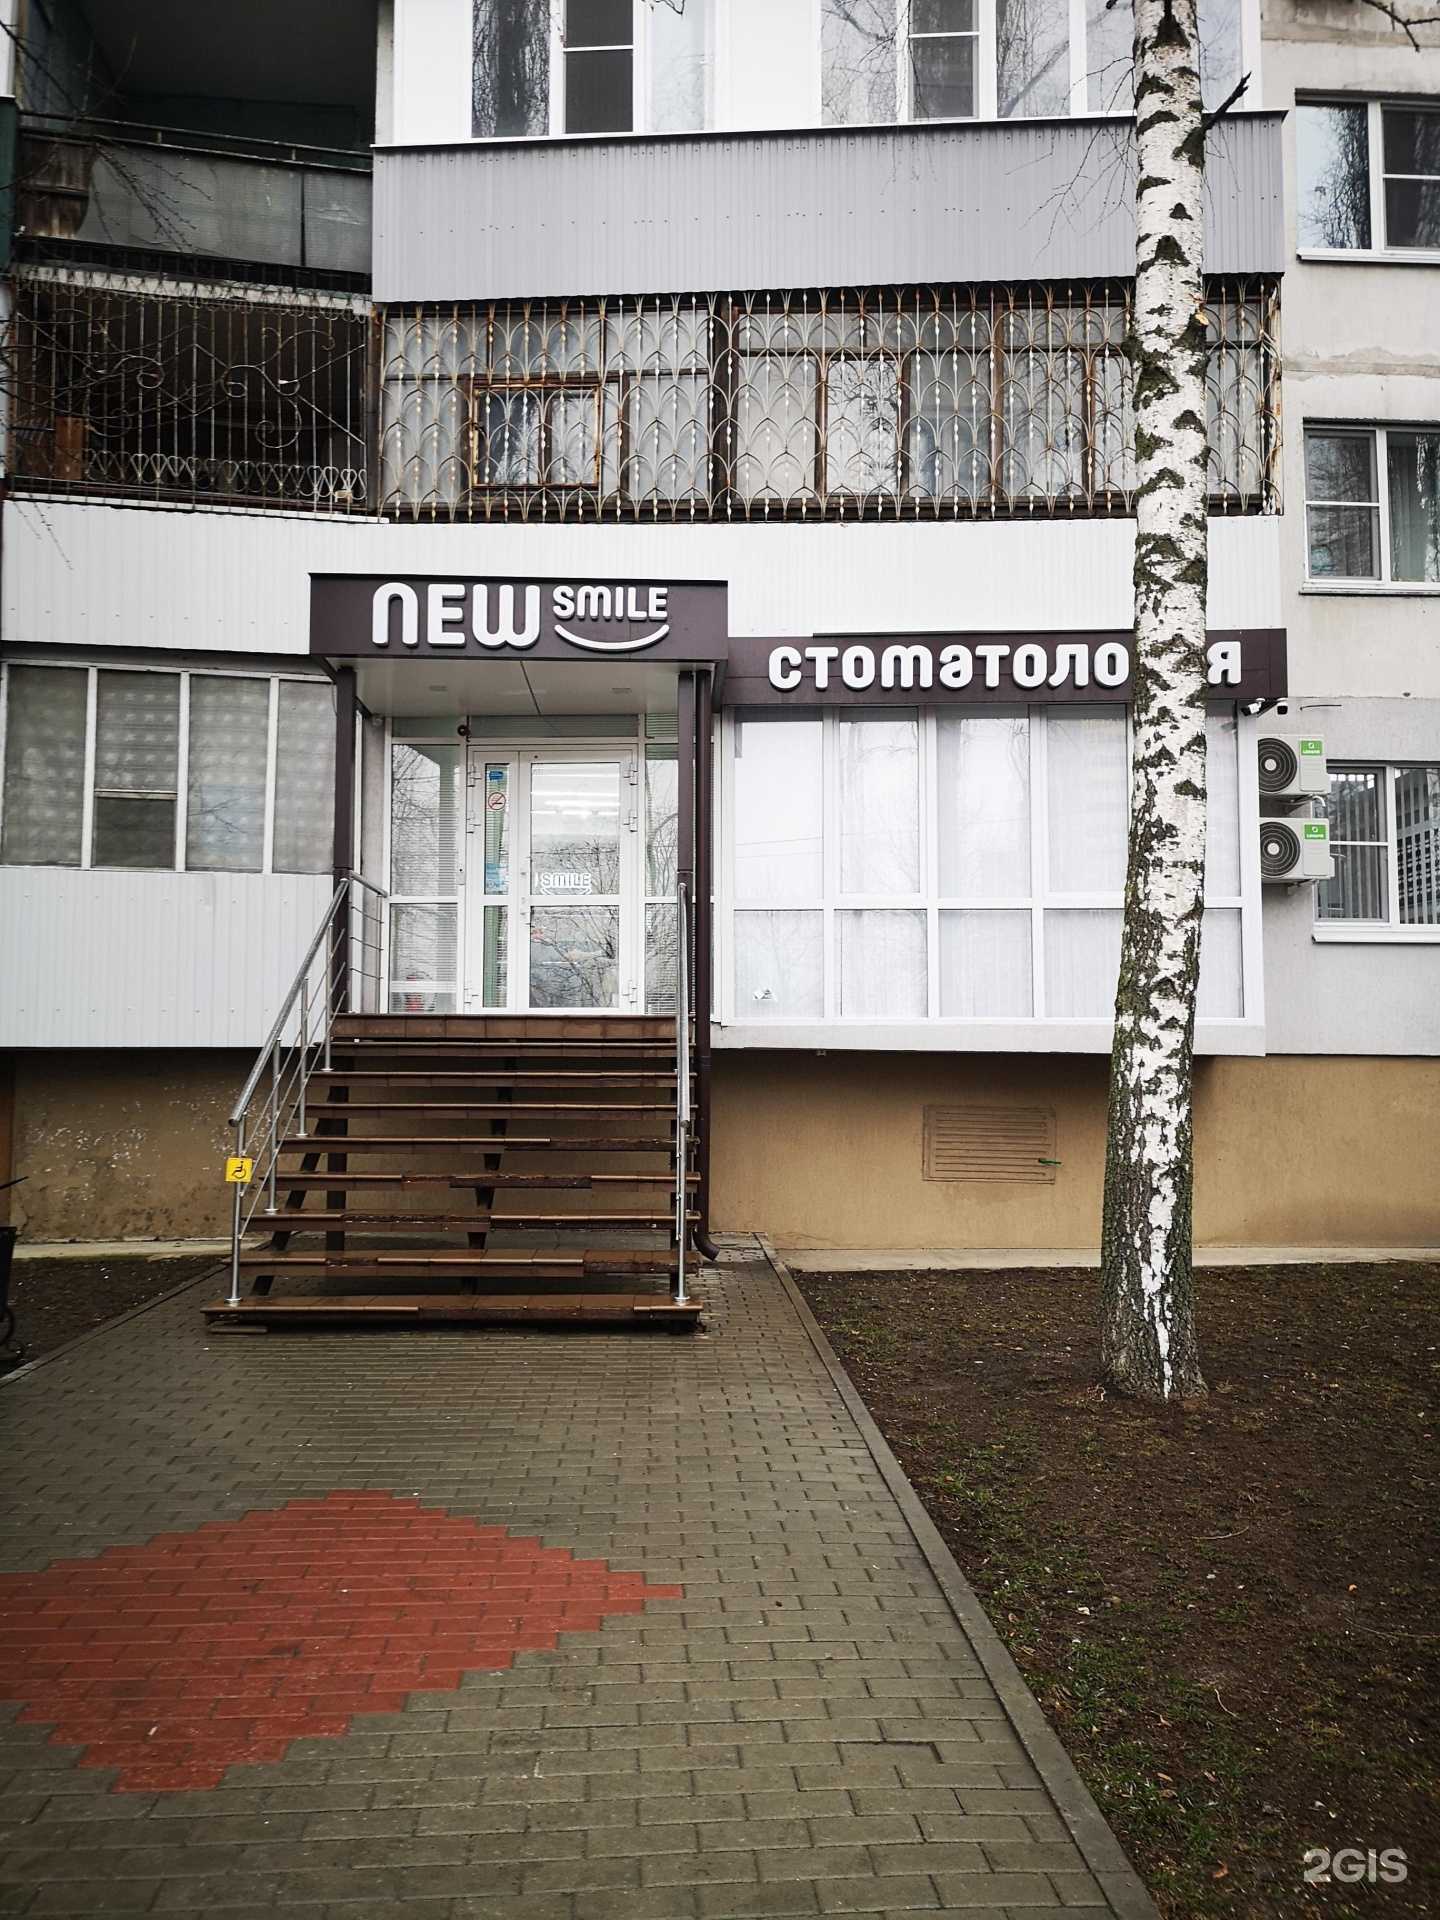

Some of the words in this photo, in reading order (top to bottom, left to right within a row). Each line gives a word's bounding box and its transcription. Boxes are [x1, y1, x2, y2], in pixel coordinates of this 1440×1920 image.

[371, 582, 541, 649] NEW
[552, 585, 669, 621] SMILE
[768, 640, 1242, 690] стоматолоя
[541, 872, 592, 888] SMILE
